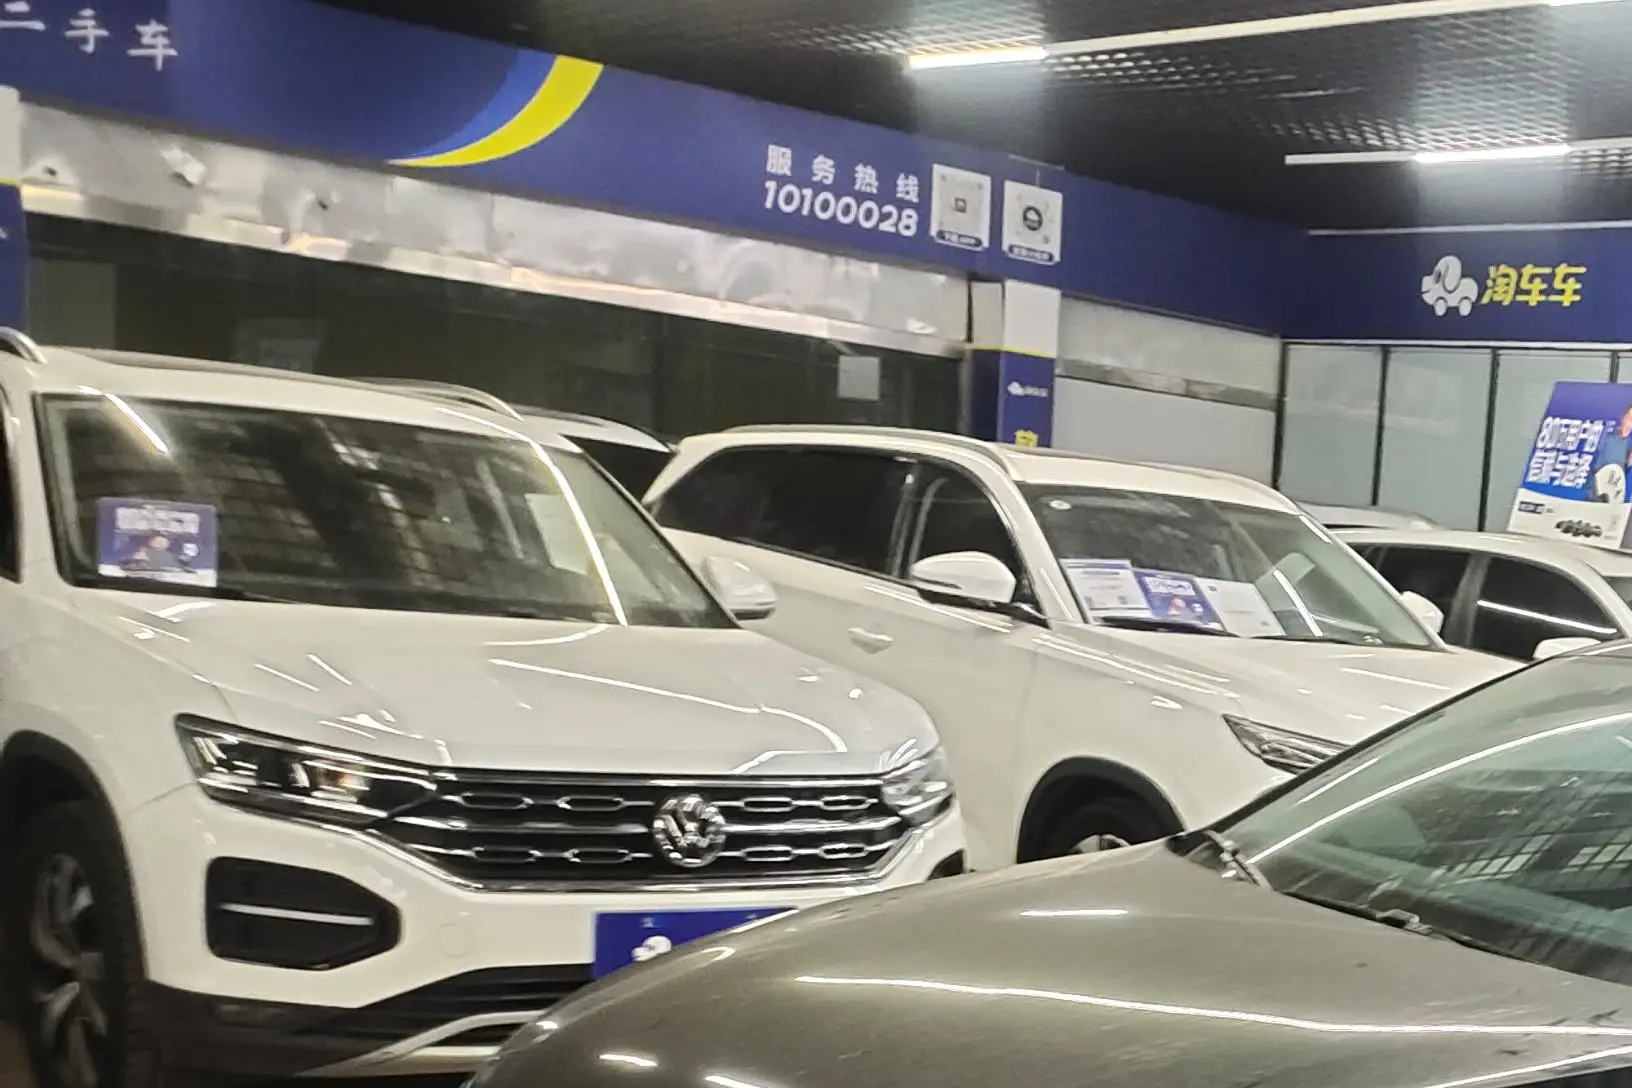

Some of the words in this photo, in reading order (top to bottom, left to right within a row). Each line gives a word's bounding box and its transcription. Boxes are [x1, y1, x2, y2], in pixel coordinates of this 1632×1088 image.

[0, 2, 179, 71] 二手车
[766, 143, 920, 203] 服务热线
[763, 180, 919, 237] 10100028
[1480, 263, 1587, 306] 淘车车
